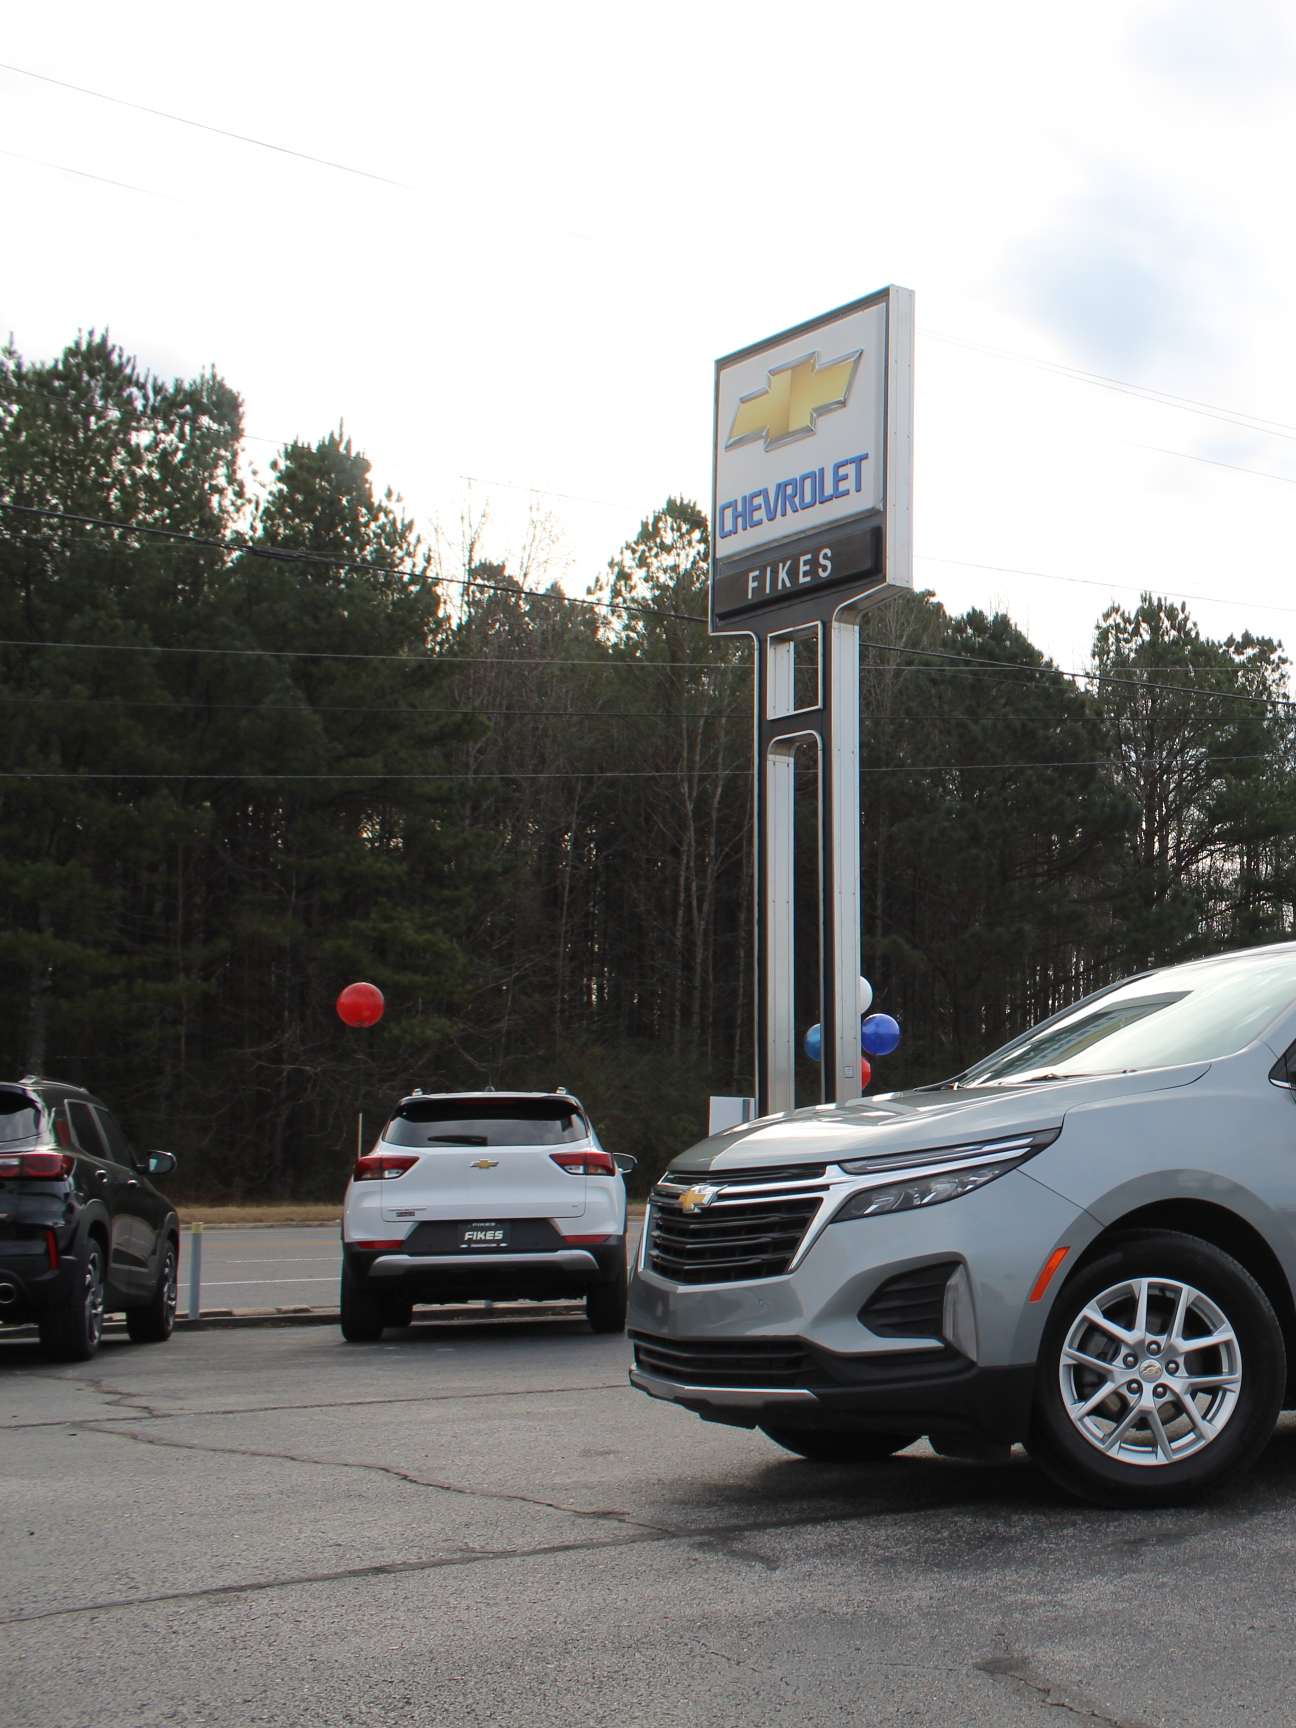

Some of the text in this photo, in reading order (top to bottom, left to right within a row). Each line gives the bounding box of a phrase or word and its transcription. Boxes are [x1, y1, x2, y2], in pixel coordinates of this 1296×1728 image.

[718, 452, 869, 539] CHEVROLET
[747, 548, 833, 600] FIKES
[464, 1230, 504, 1241] FIKES
